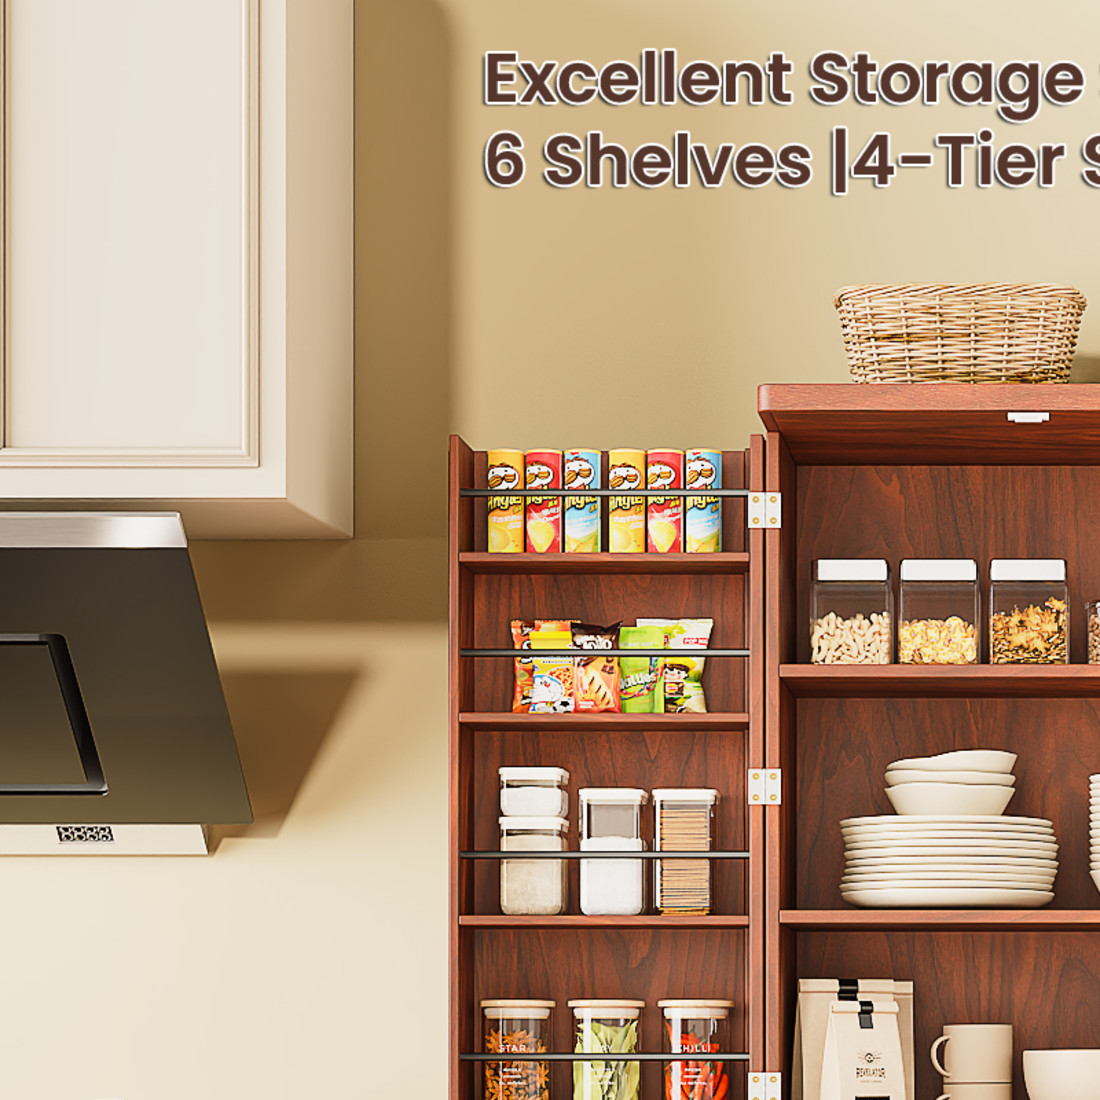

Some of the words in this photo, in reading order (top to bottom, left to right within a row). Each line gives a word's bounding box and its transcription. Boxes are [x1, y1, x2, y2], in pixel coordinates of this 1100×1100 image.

[620, 671, 657, 690] kittles
[499, 1044, 527, 1053] STAR
[679, 1044, 711, 1053] HILLI
